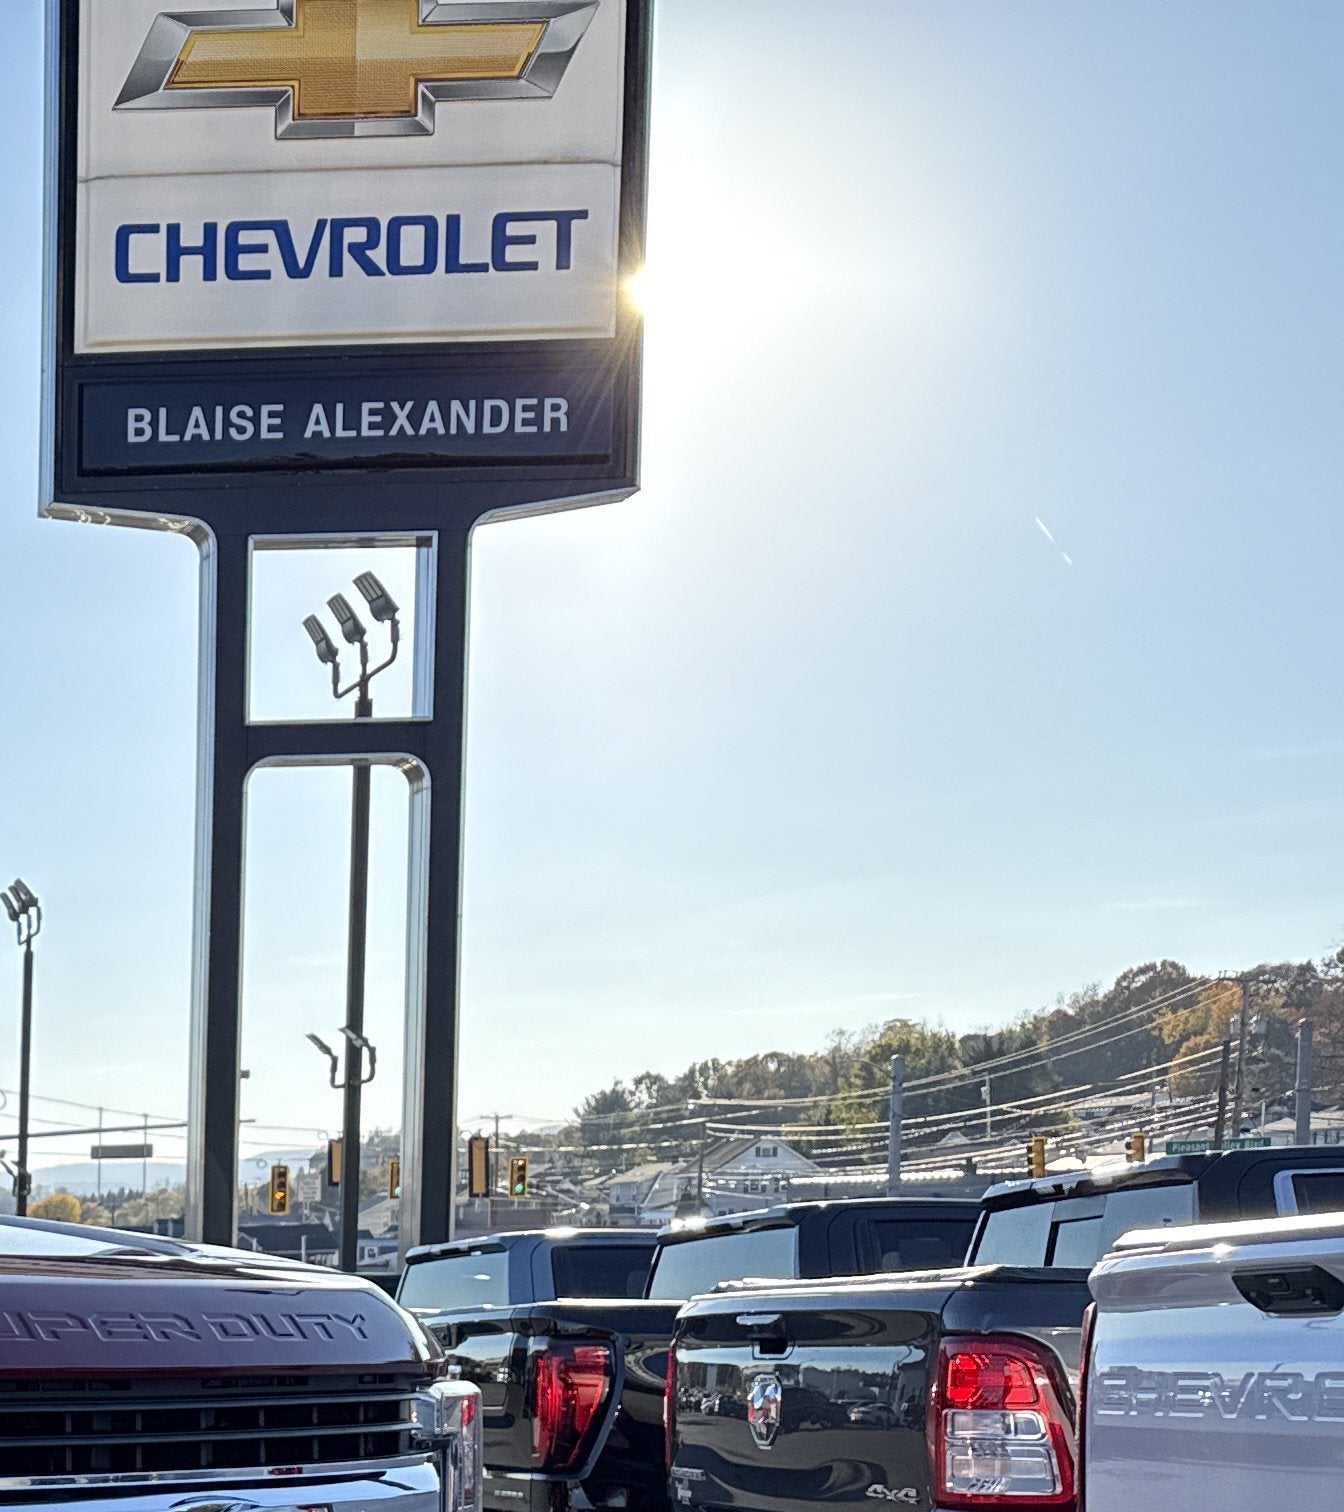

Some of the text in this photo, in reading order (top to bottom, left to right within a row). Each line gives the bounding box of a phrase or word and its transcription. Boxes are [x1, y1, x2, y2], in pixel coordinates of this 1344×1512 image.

[115, 209, 588, 283] CHEVROLET
[126, 397, 570, 442] BLAISE ALEXANDER
[202, 1312, 369, 1342] DUTY
